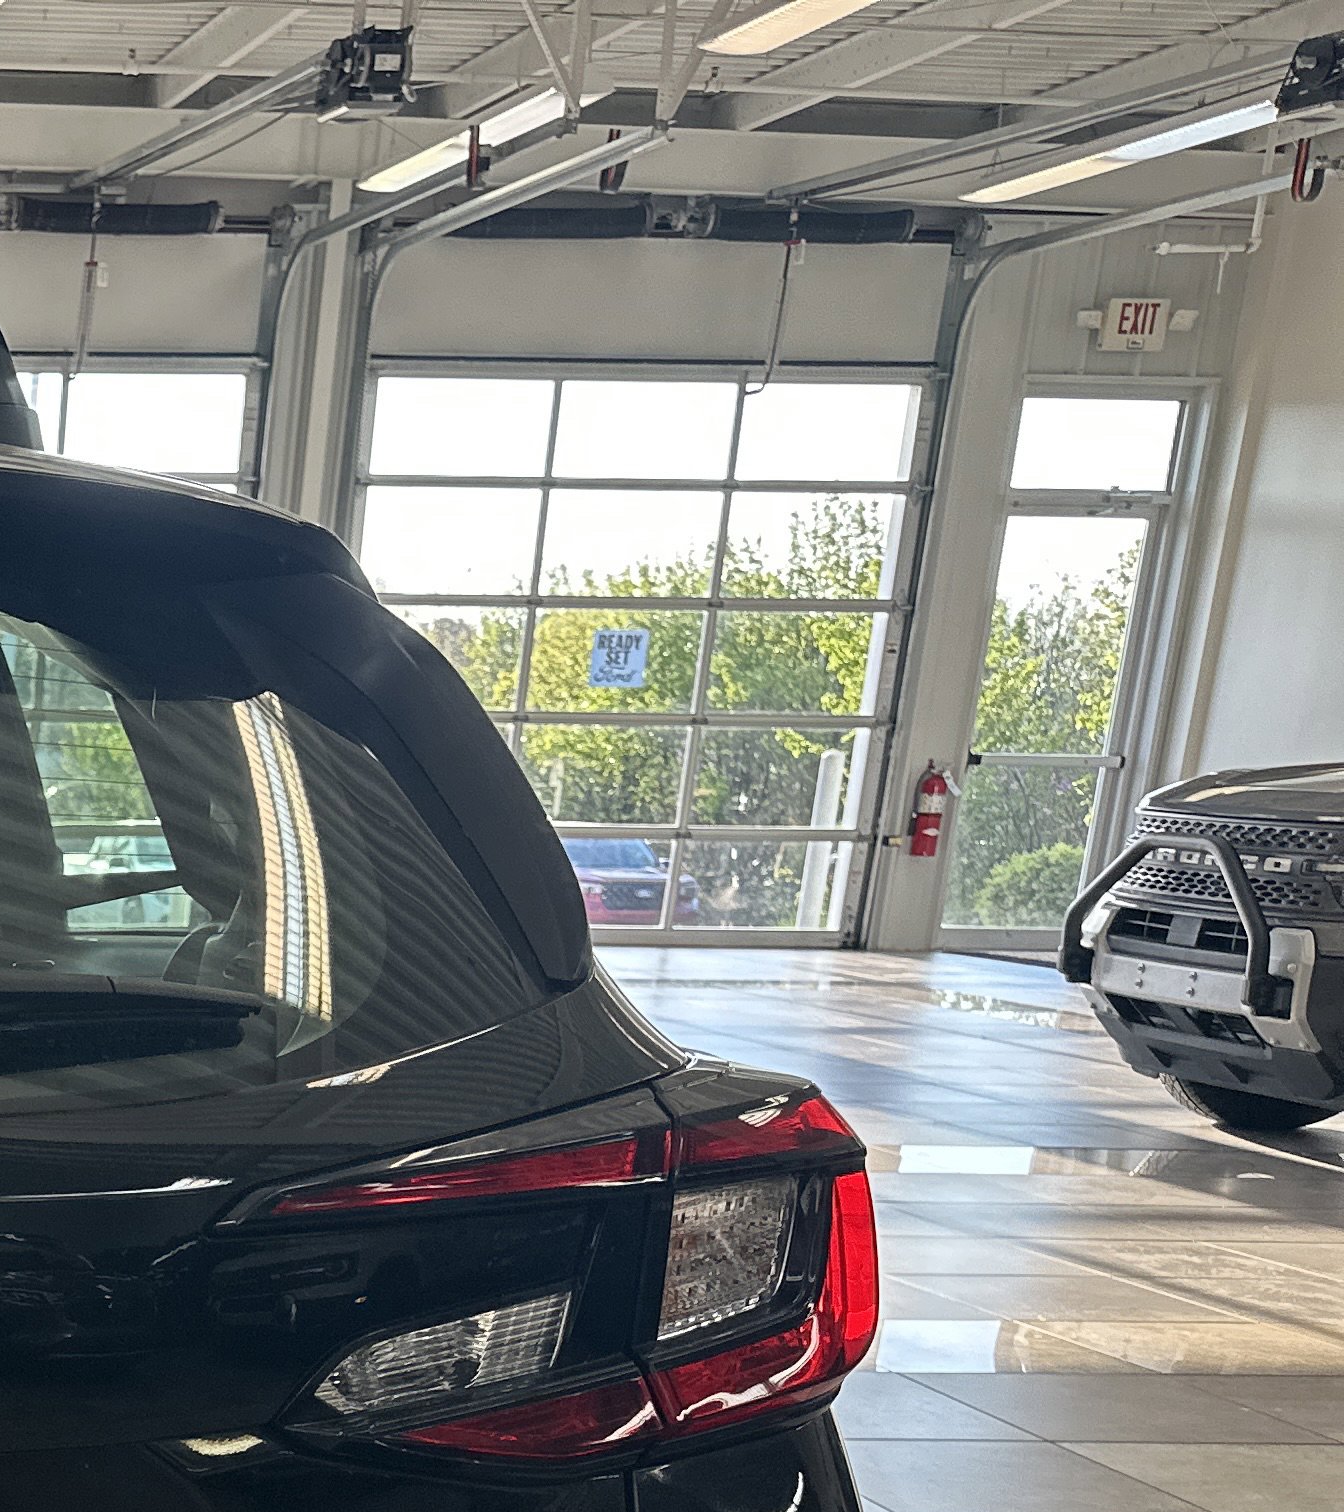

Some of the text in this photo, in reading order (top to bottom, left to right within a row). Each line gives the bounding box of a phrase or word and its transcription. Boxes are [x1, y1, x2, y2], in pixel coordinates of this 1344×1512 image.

[1117, 302, 1161, 336] EXIT
[597, 634, 644, 650] READY
[605, 650, 631, 666] SET
[593, 665, 638, 683] Ford
